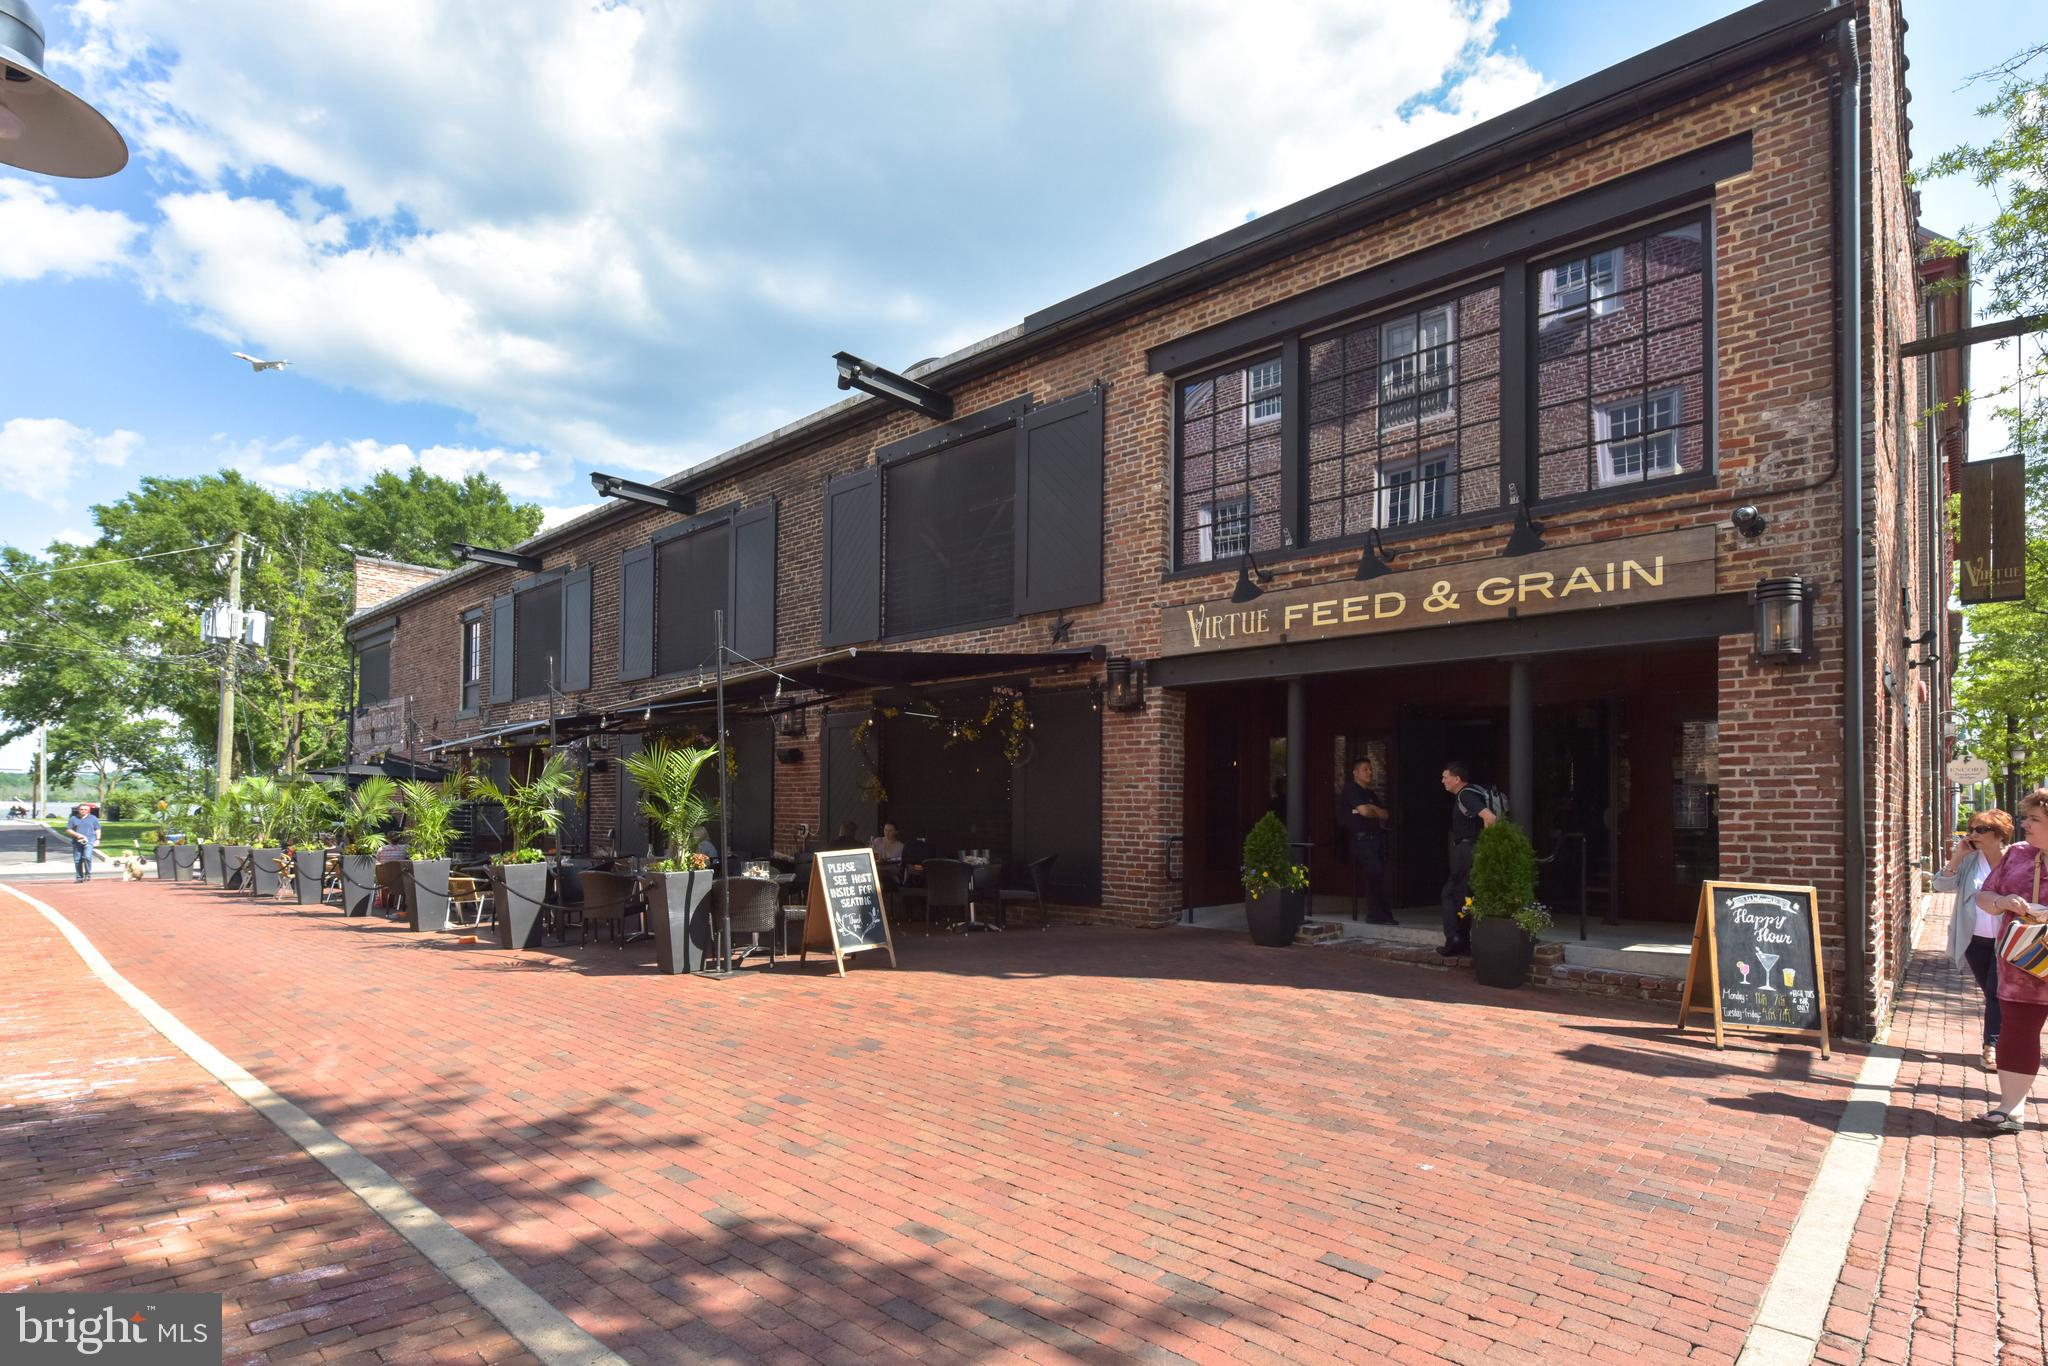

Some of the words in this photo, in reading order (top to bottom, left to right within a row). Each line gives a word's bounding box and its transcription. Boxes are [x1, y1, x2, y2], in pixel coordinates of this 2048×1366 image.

[1285, 592, 1406, 630] FEED
[1423, 580, 1460, 613] &
[1477, 556, 1664, 606] GRAIN
[827, 862, 856, 873] PLEASE
[833, 875, 848, 885] SEE
[851, 873, 872, 884] HOST
[829, 886, 855, 898] INSIDE
[858, 885, 872, 895] FOR
[840, 896, 872, 908] SEATING
[1733, 908, 1786, 929] Happy
[1754, 928, 1792, 944] Hour
